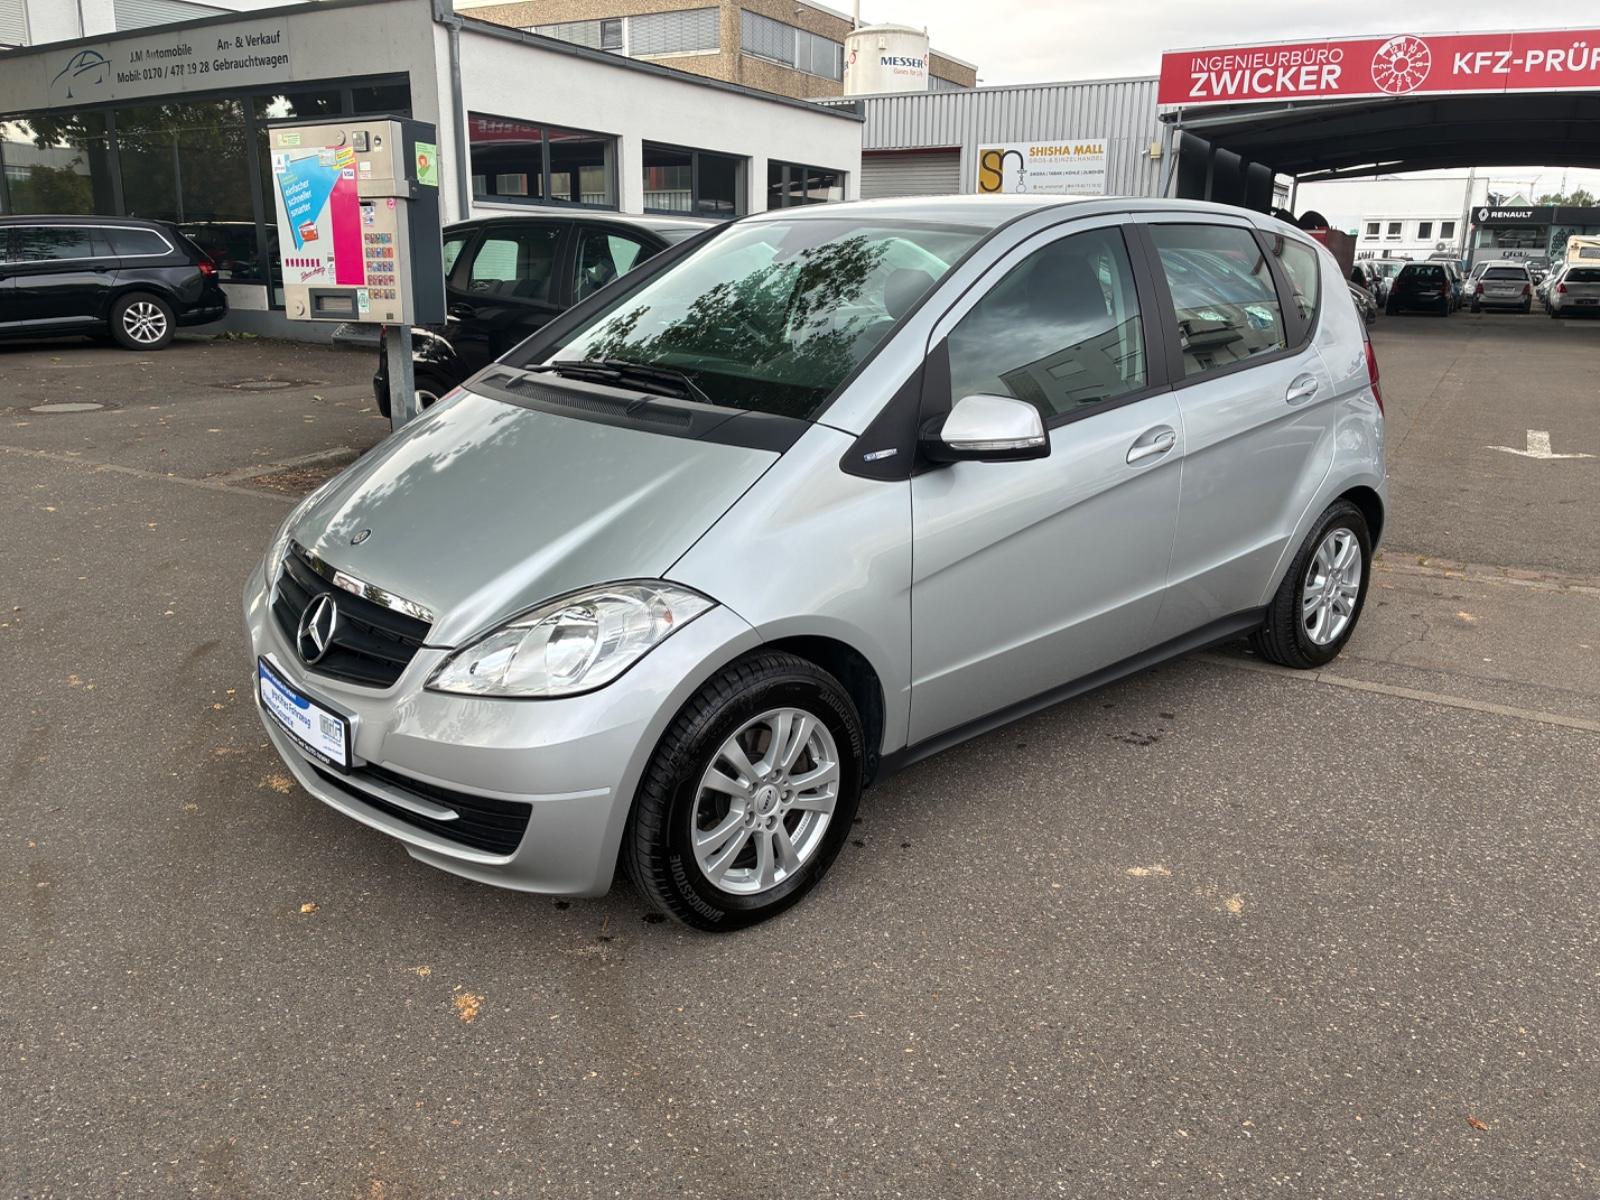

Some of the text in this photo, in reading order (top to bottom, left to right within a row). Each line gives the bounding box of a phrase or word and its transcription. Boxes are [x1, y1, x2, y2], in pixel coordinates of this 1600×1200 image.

[235, 36, 244, 48] &
[245, 30, 281, 47] Verkauf
[212, 53, 289, 72] Gebrauchtwagen
[880, 56, 923, 69] MESSER
[1191, 48, 1344, 72] INGENIEURBÜRO
[117, 71, 142, 84] Mobil:
[143, 67, 163, 80] 0170
[187, 63, 197, 75] 19
[200, 61, 210, 73] 28
[1189, 64, 1342, 97] ZWICKER
[1029, 144, 1104, 157] SHISHA MALL
[287, 190, 312, 207] schneller
[819, 688, 862, 758] BRIDGESTONE
[669, 854, 725, 922] BRIDGESTONE
